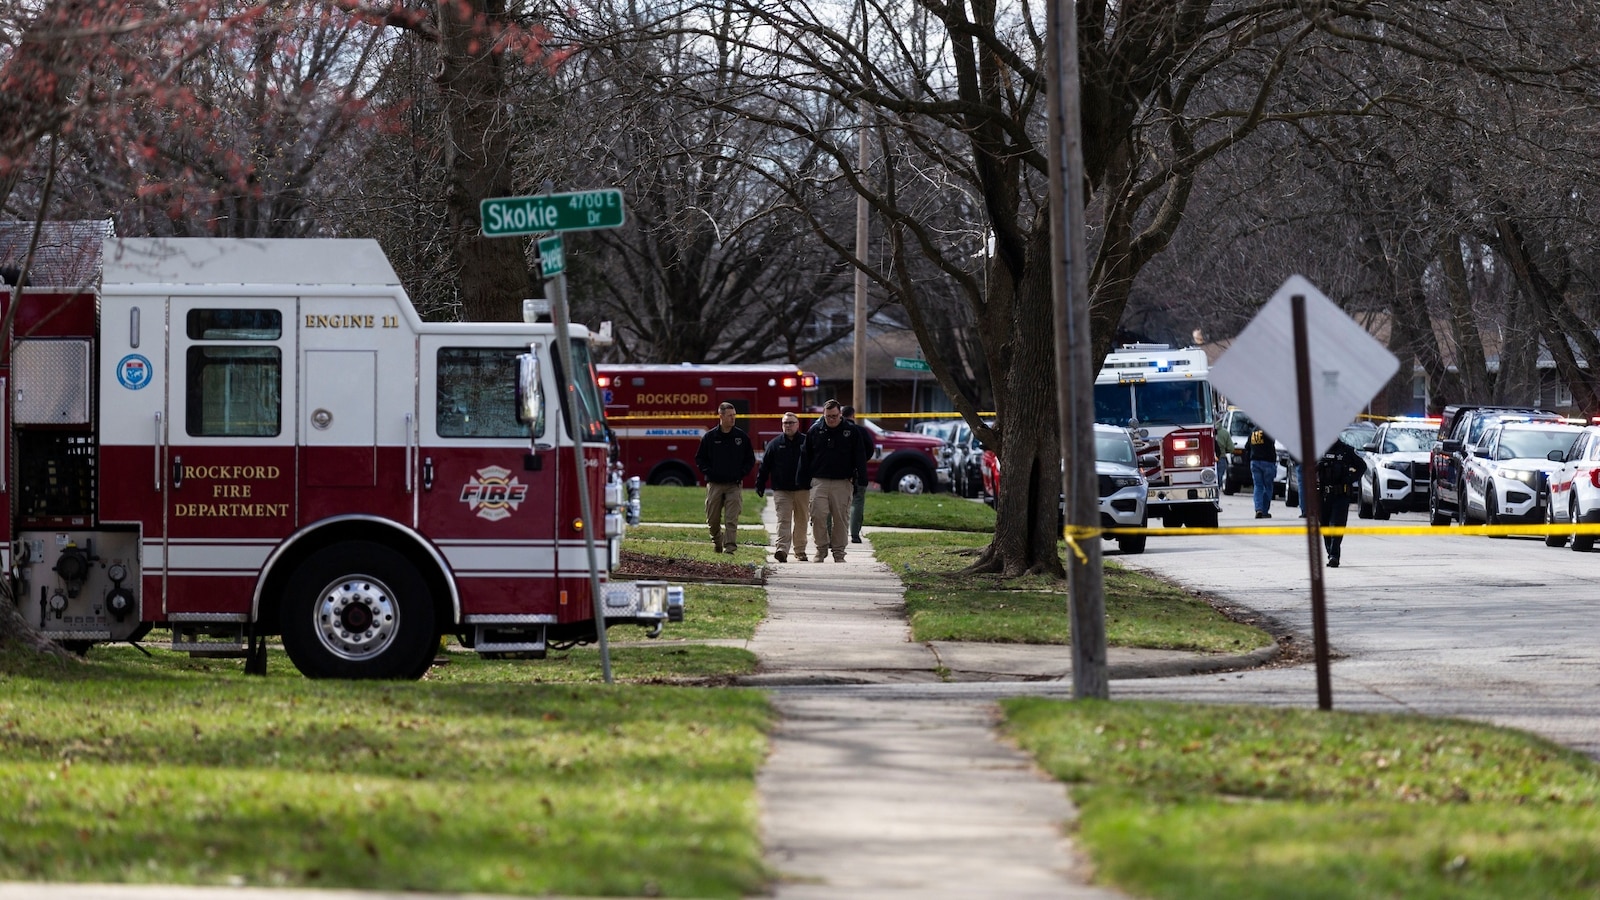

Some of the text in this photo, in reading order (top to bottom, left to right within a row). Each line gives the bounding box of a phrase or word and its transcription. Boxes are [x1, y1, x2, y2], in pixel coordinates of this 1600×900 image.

[489, 192, 616, 230] Skokie 4700 E
[587, 210, 602, 224] Dr
[305, 314, 399, 329] ENGINE 11
[613, 376, 622, 387] 6
[636, 393, 709, 405] ROCKFORD
[645, 428, 700, 436] AMBULANCE
[184, 466, 280, 479] ROCKFORD
[213, 485, 252, 498] FIRE
[460, 484, 528, 502] FIRE
[175, 503, 289, 517] DEPARTMENT
